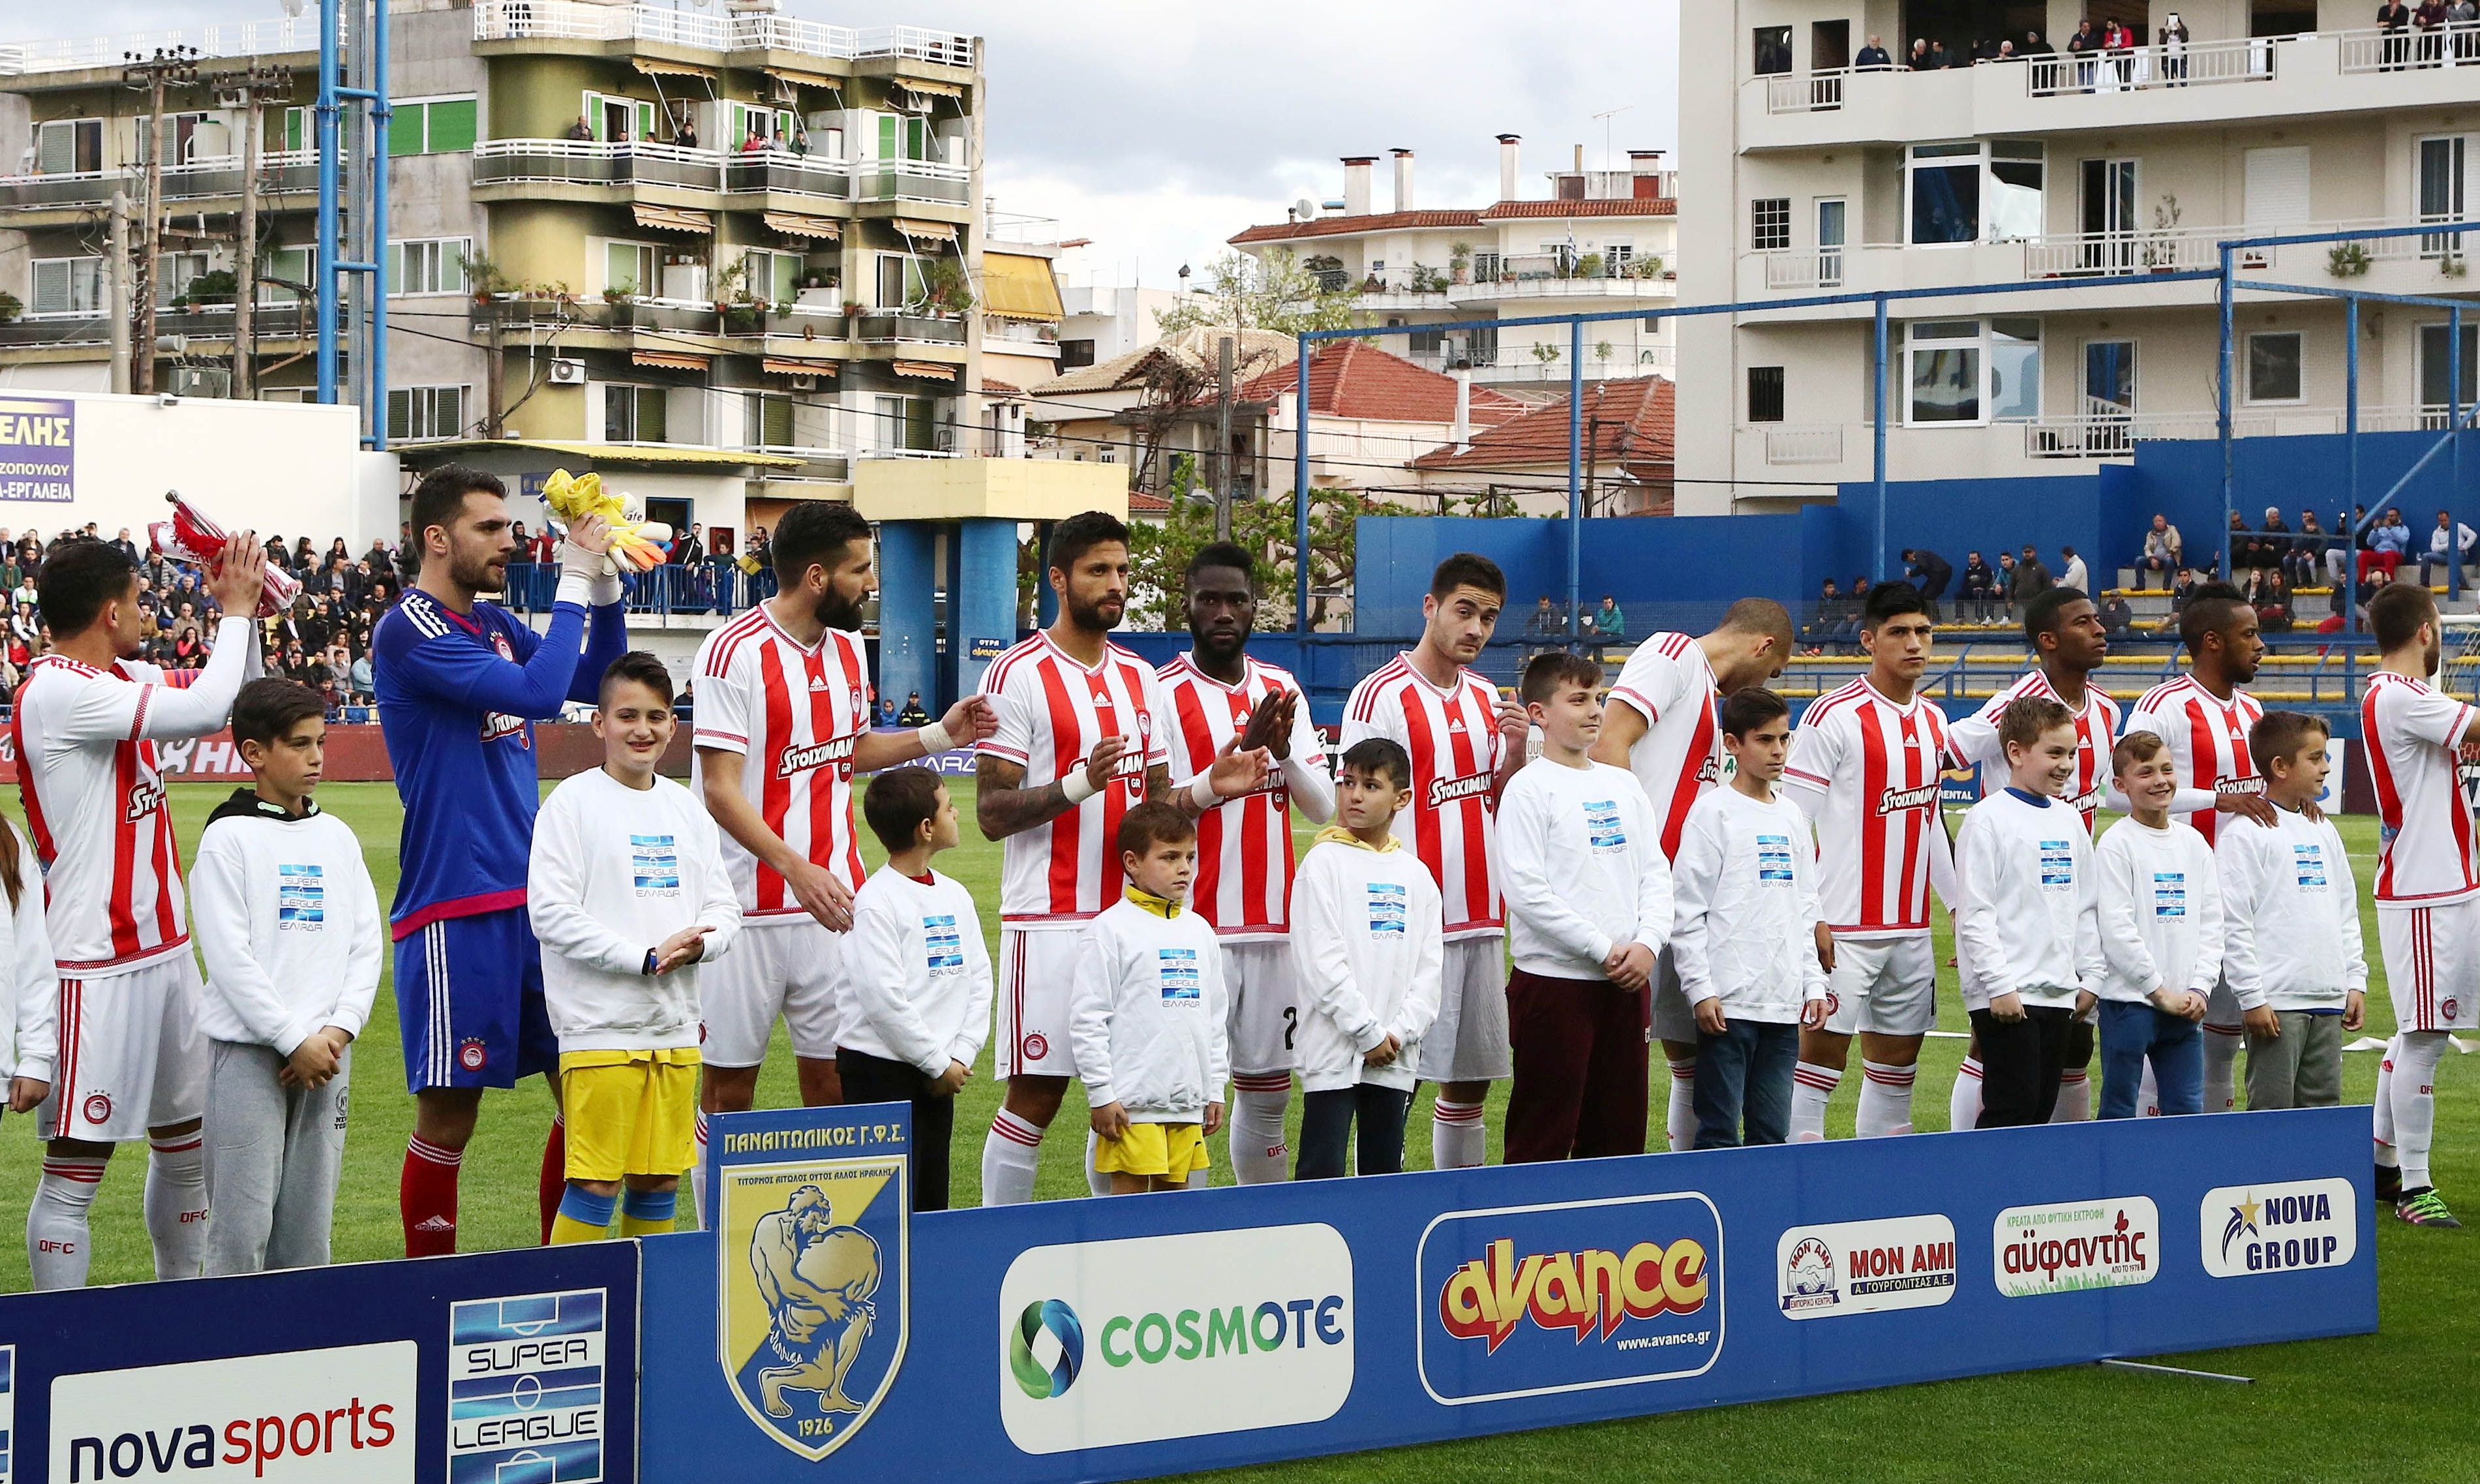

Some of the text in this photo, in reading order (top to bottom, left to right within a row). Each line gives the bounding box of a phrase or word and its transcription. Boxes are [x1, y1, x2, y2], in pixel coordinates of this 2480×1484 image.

[627, 512, 643, 521] afe
[781, 736, 854, 774] STOIXIMAN
[724, 1127, 856, 1155] ΠΑΝΑΙΤΩΛΙΚΟΣ
[738, 1168, 892, 1186] ΤΙΤΟΡΜΟΣ ΑΙΤΩΛΟΣ ΟΥΤΟΣ ΑΛΛΟΣ ΗΡΑΚΛΗΣ
[2007, 1209, 2104, 1228] ΚΡΕΑΤΑ ΑΠΟ ΦΥΤΙΚΗ ΕΚΤΡΟΦΗ
[2265, 1194, 2331, 1226] NOVA
[39, 1240, 74, 1254] OFC
[1850, 1241, 1954, 1279] MON AMI
[2246, 1236, 2337, 1271] GROUP
[1442, 1238, 1708, 1346] avance
[1855, 1277, 1950, 1294] Α. ΓΟΥΡΓΟΛΙΤΣΑΣ Α.Ε.
[1791, 1296, 1832, 1308] ΕΜΠΟΡΙΚΟ ΚΕΝΤΡΟ
[1100, 1295, 1345, 1367] COSMOTE
[1617, 1331, 1711, 1351] www.avance.gr
[468, 1339, 587, 1373] SUPER
[70, 1397, 395, 1483] novasports
[454, 1410, 597, 1449] LEAGUE
[798, 1417, 834, 1437] 1926
